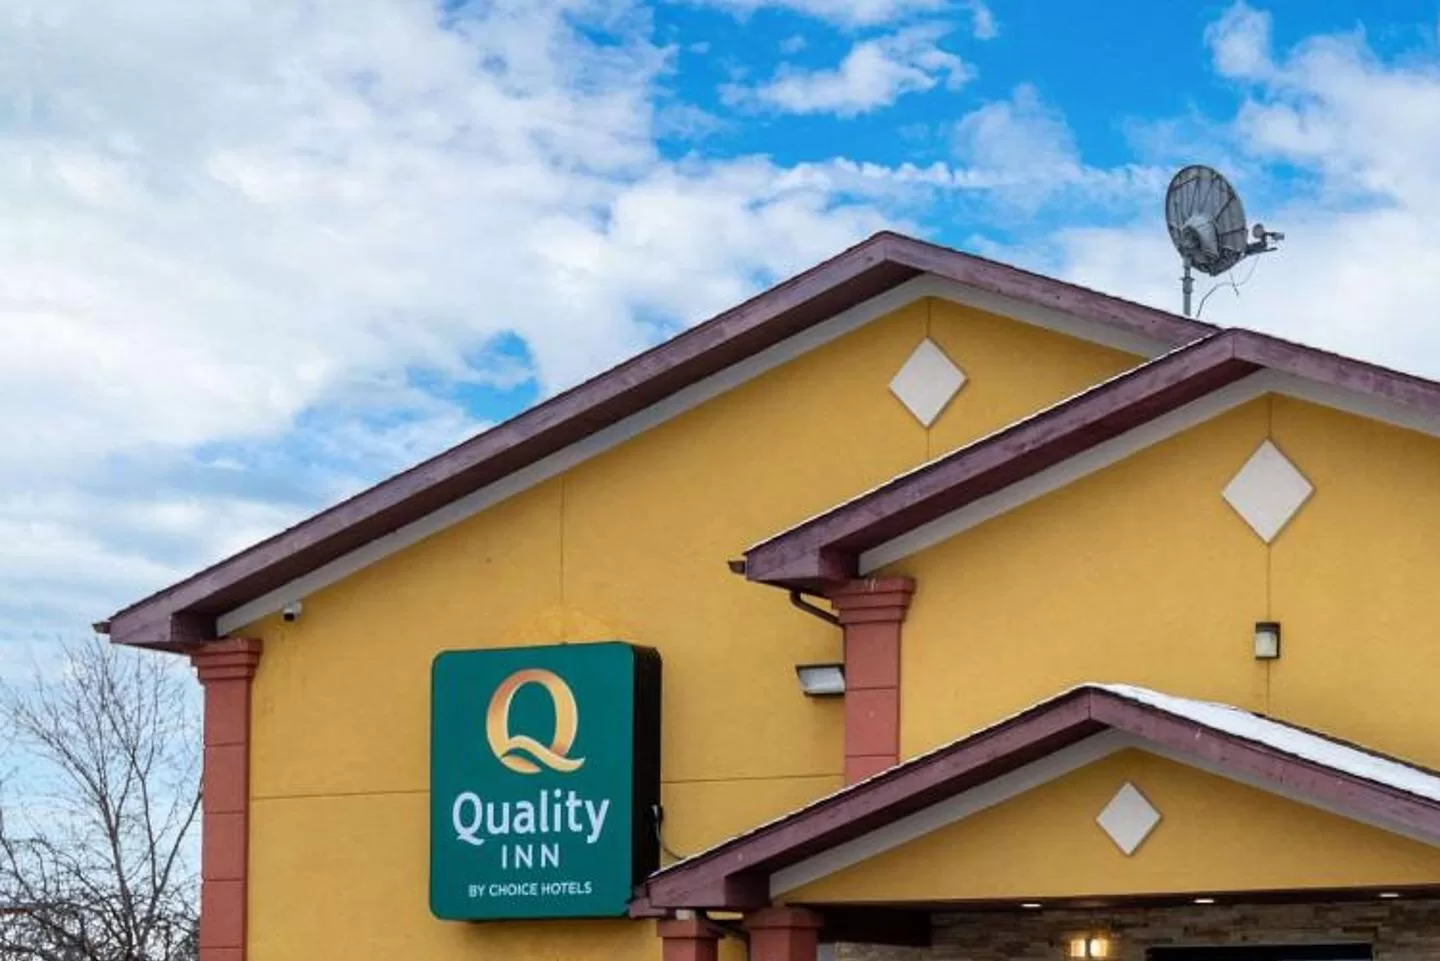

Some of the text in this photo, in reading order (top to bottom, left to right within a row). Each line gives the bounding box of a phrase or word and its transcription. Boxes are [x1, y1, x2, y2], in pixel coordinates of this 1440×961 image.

[485, 668, 586, 774] Q
[452, 788, 610, 846] Quality
[501, 843, 560, 869] INN
[468, 880, 593, 898] BY CHOICE HOTELS
